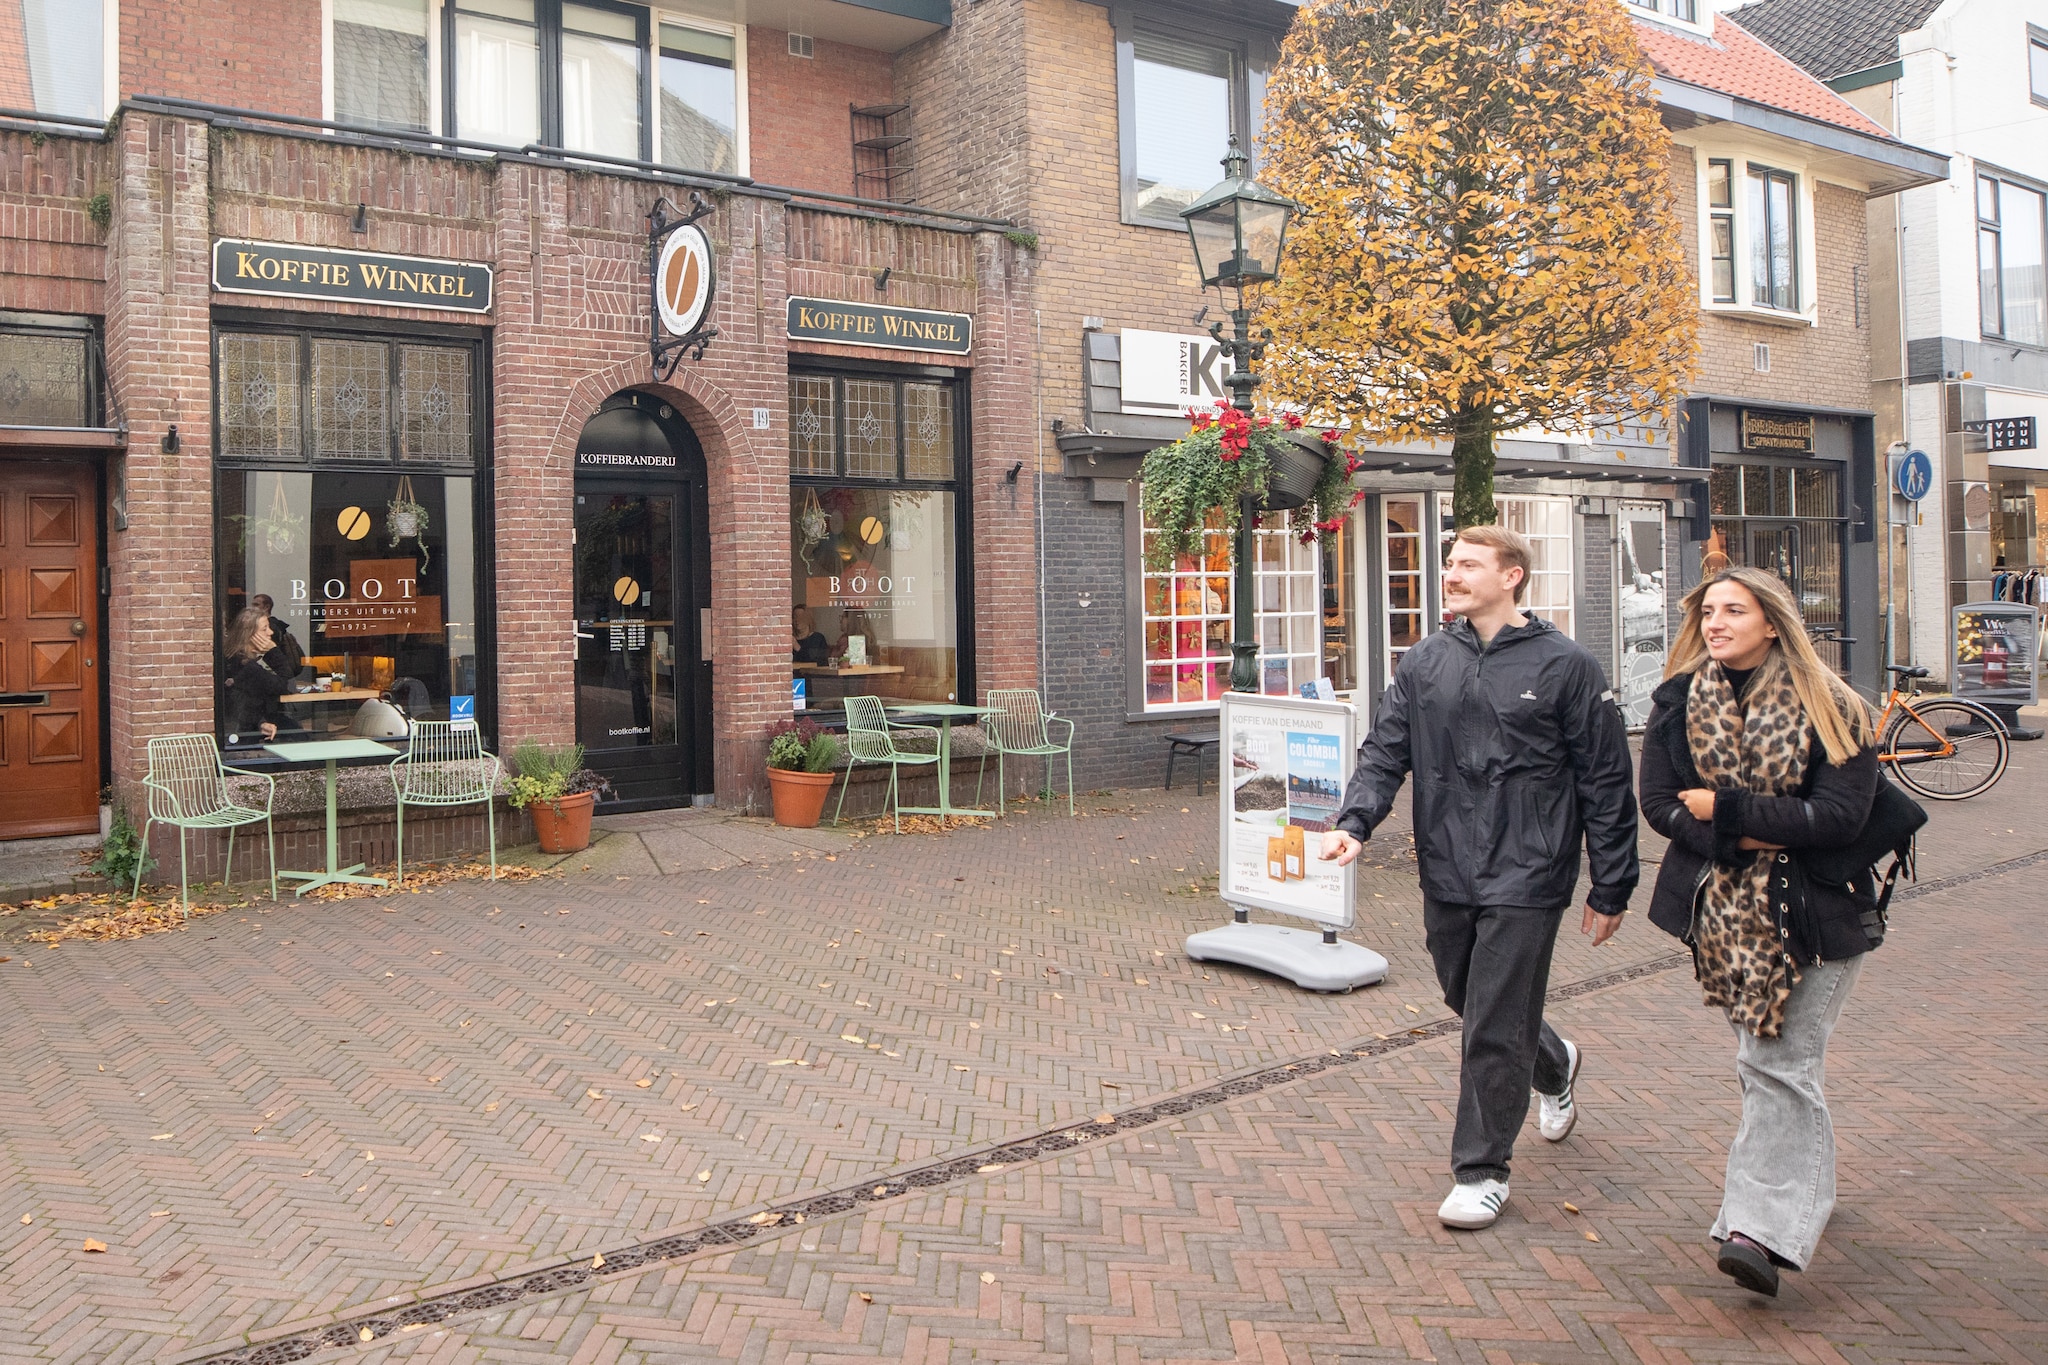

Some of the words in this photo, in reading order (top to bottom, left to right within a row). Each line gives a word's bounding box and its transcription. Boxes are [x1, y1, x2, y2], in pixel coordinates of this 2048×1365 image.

[236, 252, 349, 286] KOFFIE
[358, 263, 474, 297] WINKEL
[798, 307, 876, 334] KOFFIE
[882, 315, 961, 342] WINKEL
[1180, 341, 1188, 395] BAKKER
[757, 411, 768, 427] 19
[1995, 420, 2028, 430] VAN
[1995, 429, 2028, 438] VUU
[1995, 438, 2028, 447] REN
[580, 454, 676, 467] KOFFIEBRANDERIJ
[290, 578, 416, 600] BOOT
[829, 576, 915, 593] BOOT
[290, 608, 350, 616] BRANDERS
[382, 607, 417, 615] BAARN
[1232, 715, 1260, 725] KOFFIE
[1261, 717, 1278, 726] VAN
[1280, 718, 1291, 727] DE
[1292, 719, 1323, 730] MAAND
[609, 726, 650, 736] bootkoffie.nl
[1246, 738, 1270, 754] BOOT
[1289, 742, 1338, 760] COLOMBIA
